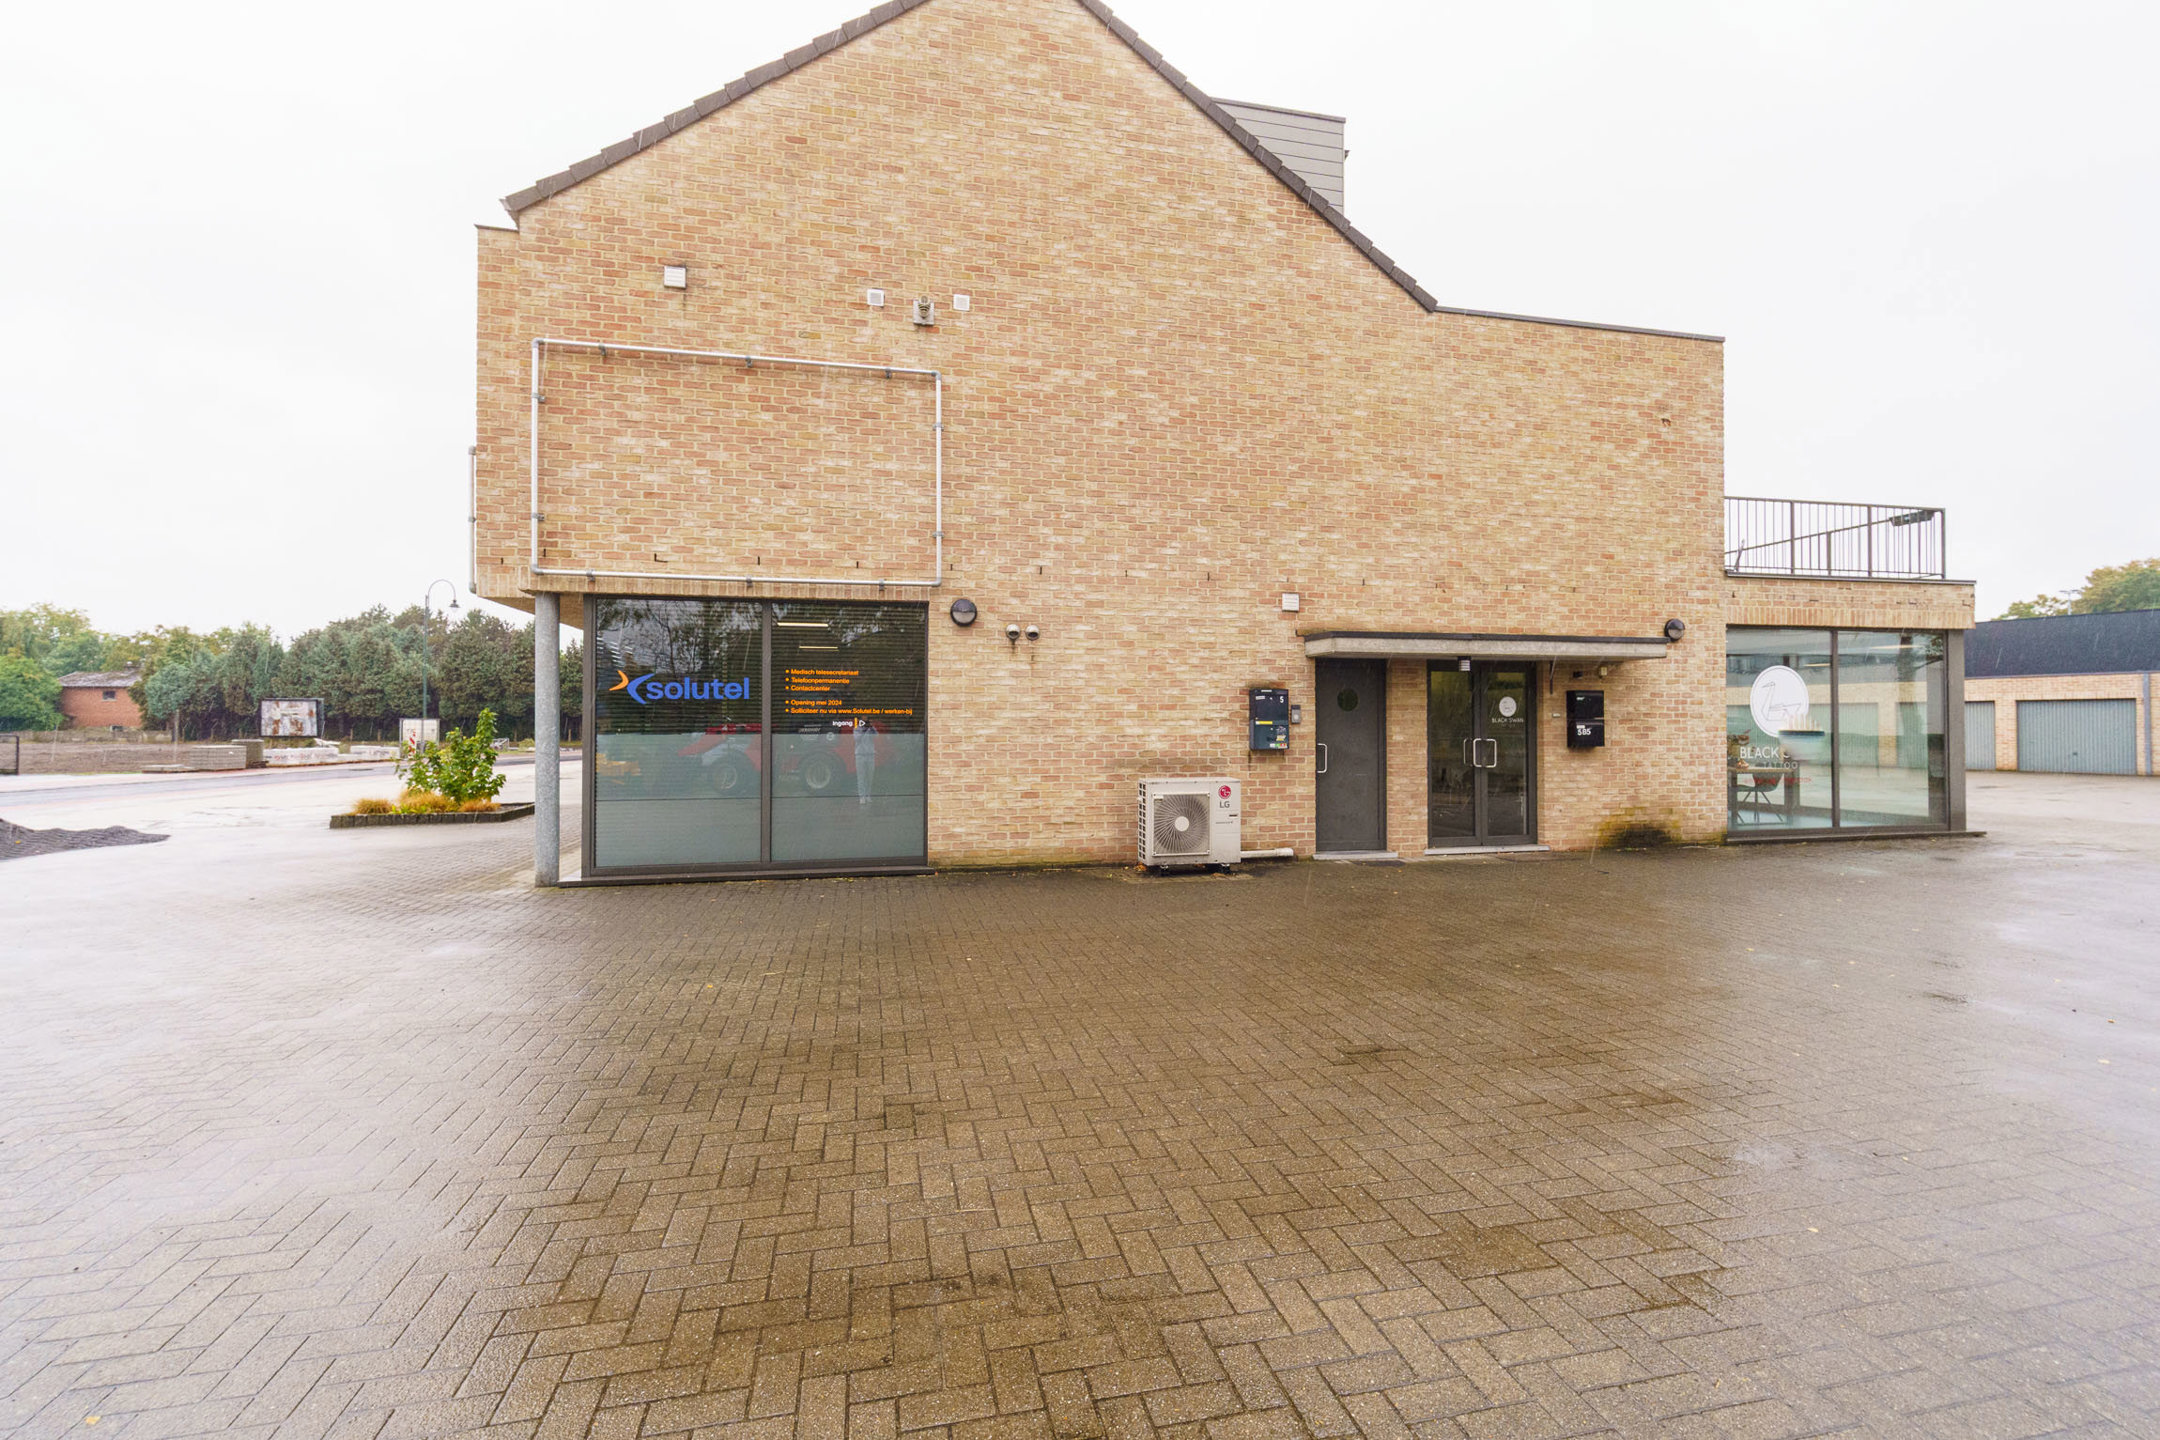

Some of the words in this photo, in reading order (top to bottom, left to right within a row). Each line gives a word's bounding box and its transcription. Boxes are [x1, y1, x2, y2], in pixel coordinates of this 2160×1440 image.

[791, 677, 850, 685] Telefoonpermanentie
[646, 676, 750, 700] solutel
[1740, 746, 1780, 759] BLACK
[1764, 761, 1799, 770] TATTOO
[1219, 801, 1231, 809] LG
